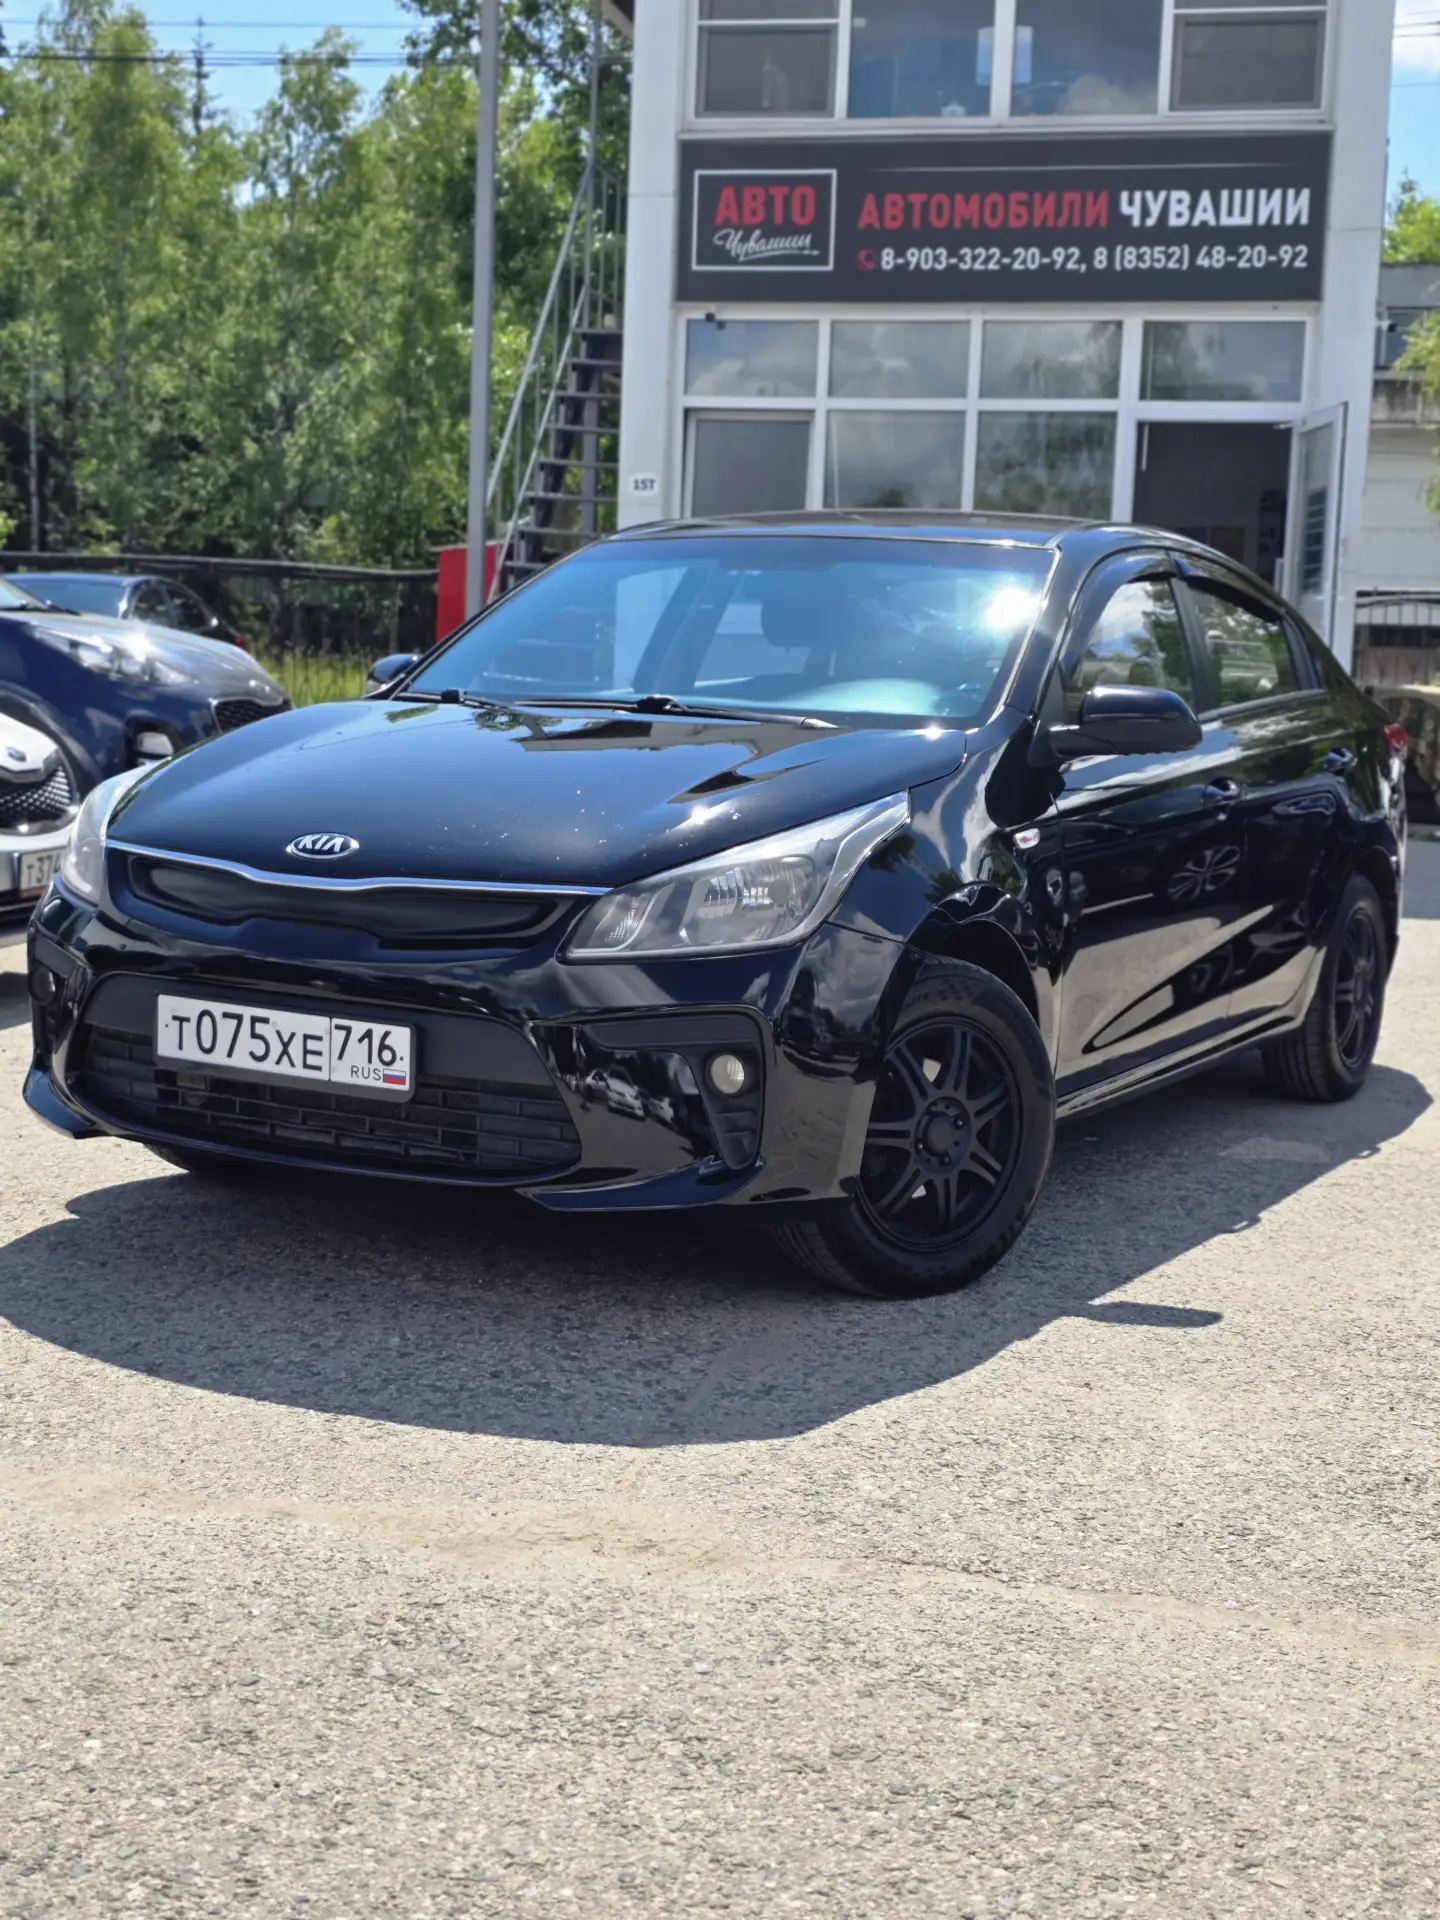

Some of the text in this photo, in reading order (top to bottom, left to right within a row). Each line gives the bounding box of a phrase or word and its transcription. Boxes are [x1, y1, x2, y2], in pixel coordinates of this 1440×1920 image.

[714, 185, 816, 225] АВТО
[857, 187, 1311, 229] АВТОМОБИЛИ ЧУВАШИИ
[880, 244, 1309, 274] 8-903-322-20-92, 8 (8352) 48-20-92
[297, 834, 345, 853] KIA
[334, 1023, 397, 1067] 716
[350, 1064, 382, 1082] RUS
